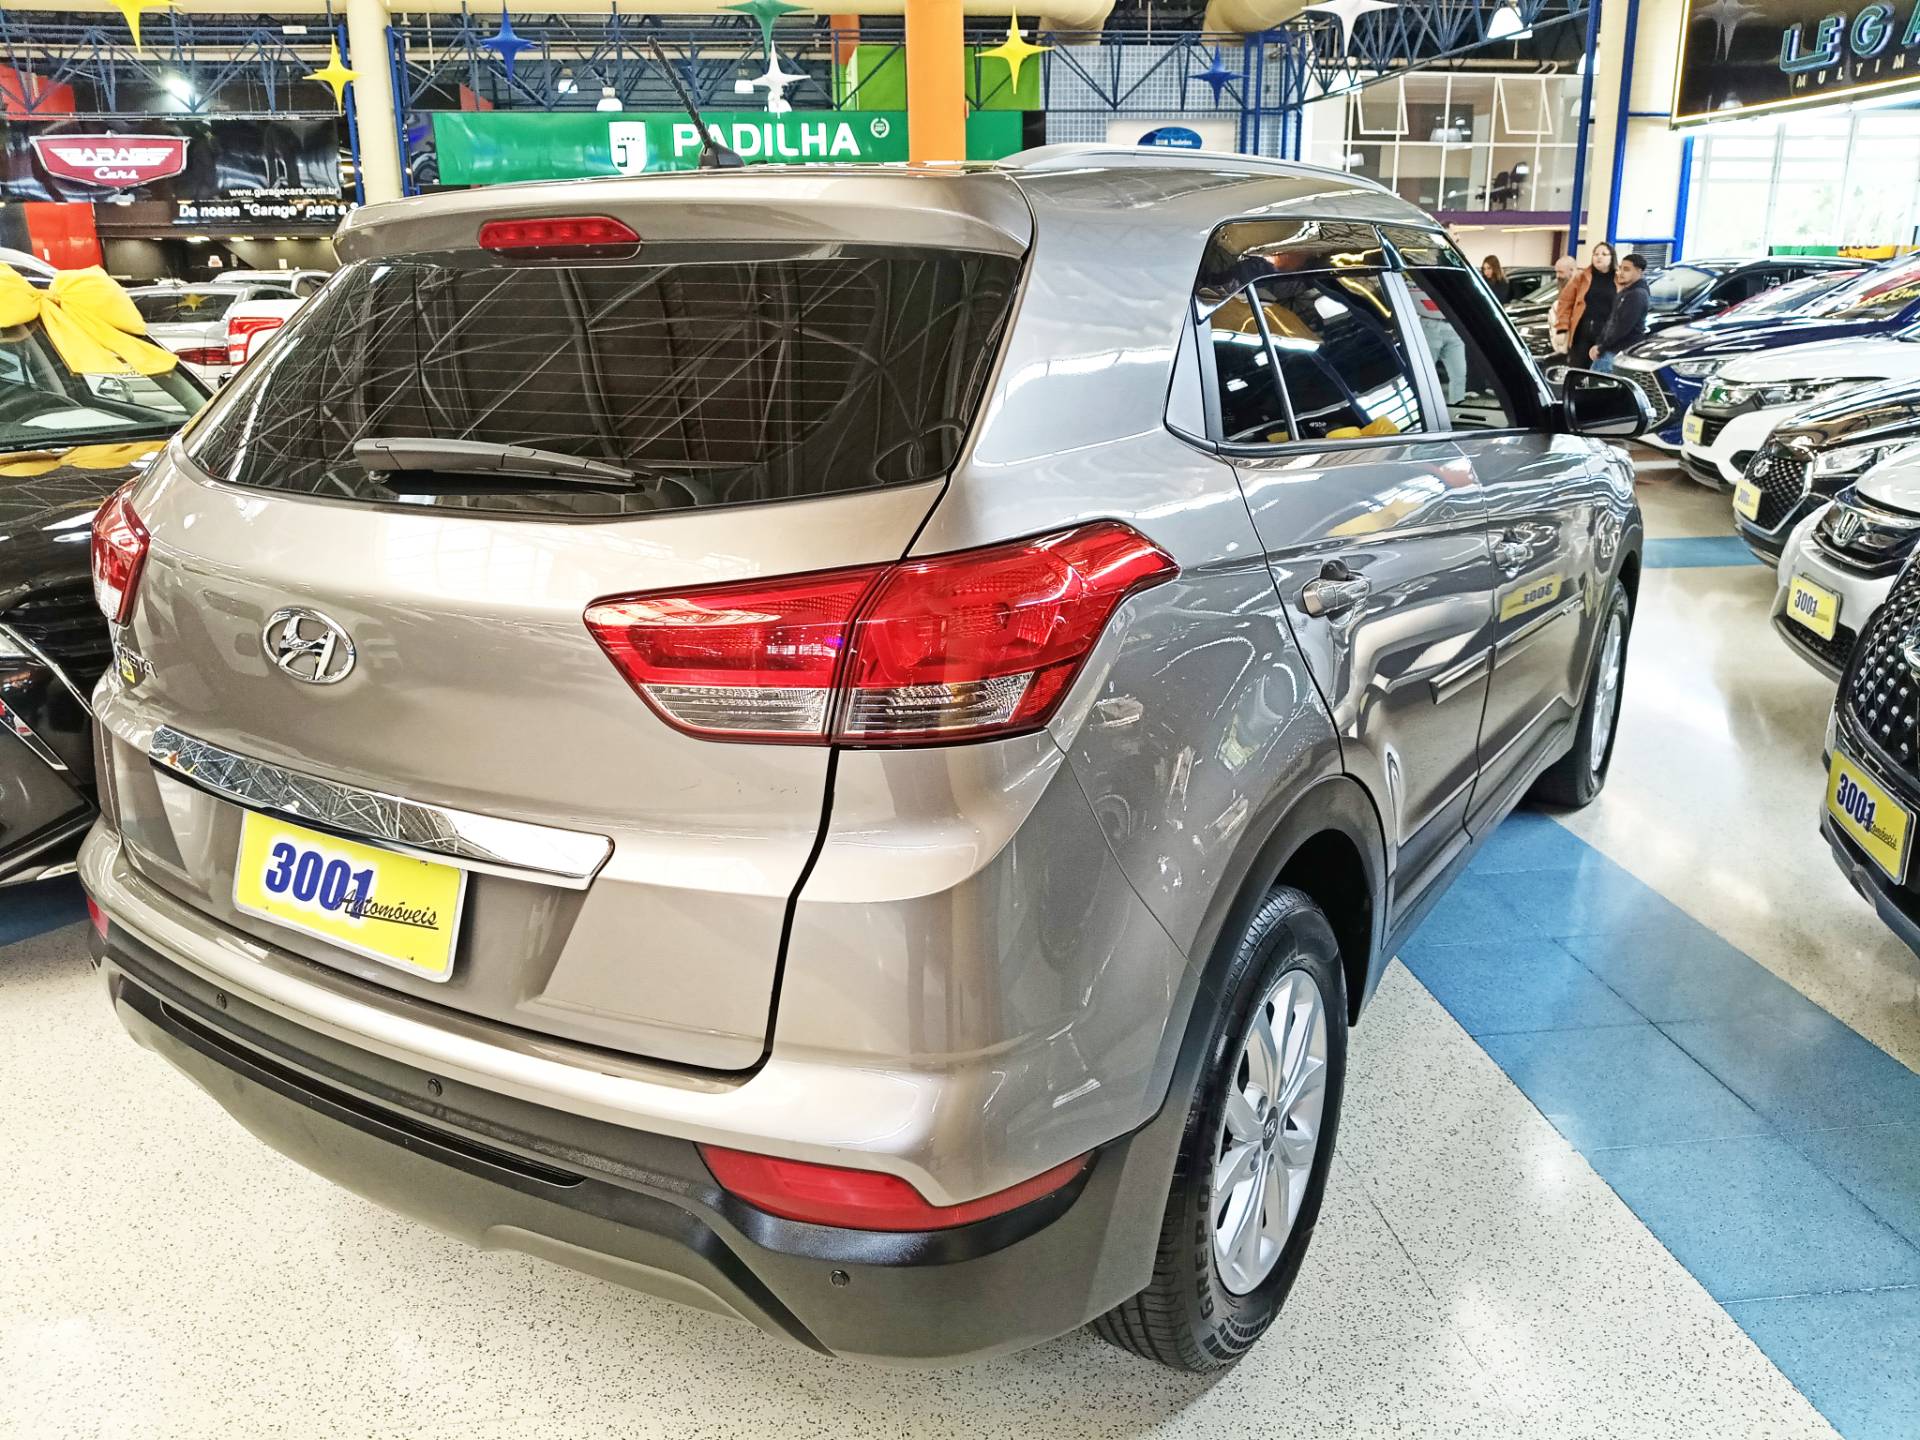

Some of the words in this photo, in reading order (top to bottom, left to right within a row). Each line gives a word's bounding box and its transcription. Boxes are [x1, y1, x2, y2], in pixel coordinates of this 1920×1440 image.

[1796, 54, 1920, 88] MULTIM
[672, 123, 861, 157] PADILHA
[93, 166, 139, 180] Cars
[229, 187, 341, 198] www.garagecars.com.br
[179, 205, 198, 217] Da
[200, 204, 240, 217] nossa
[306, 204, 336, 217] para
[1794, 588, 1818, 618] 3001
[1837, 772, 1876, 832] 3001
[265, 842, 374, 919] 3001
